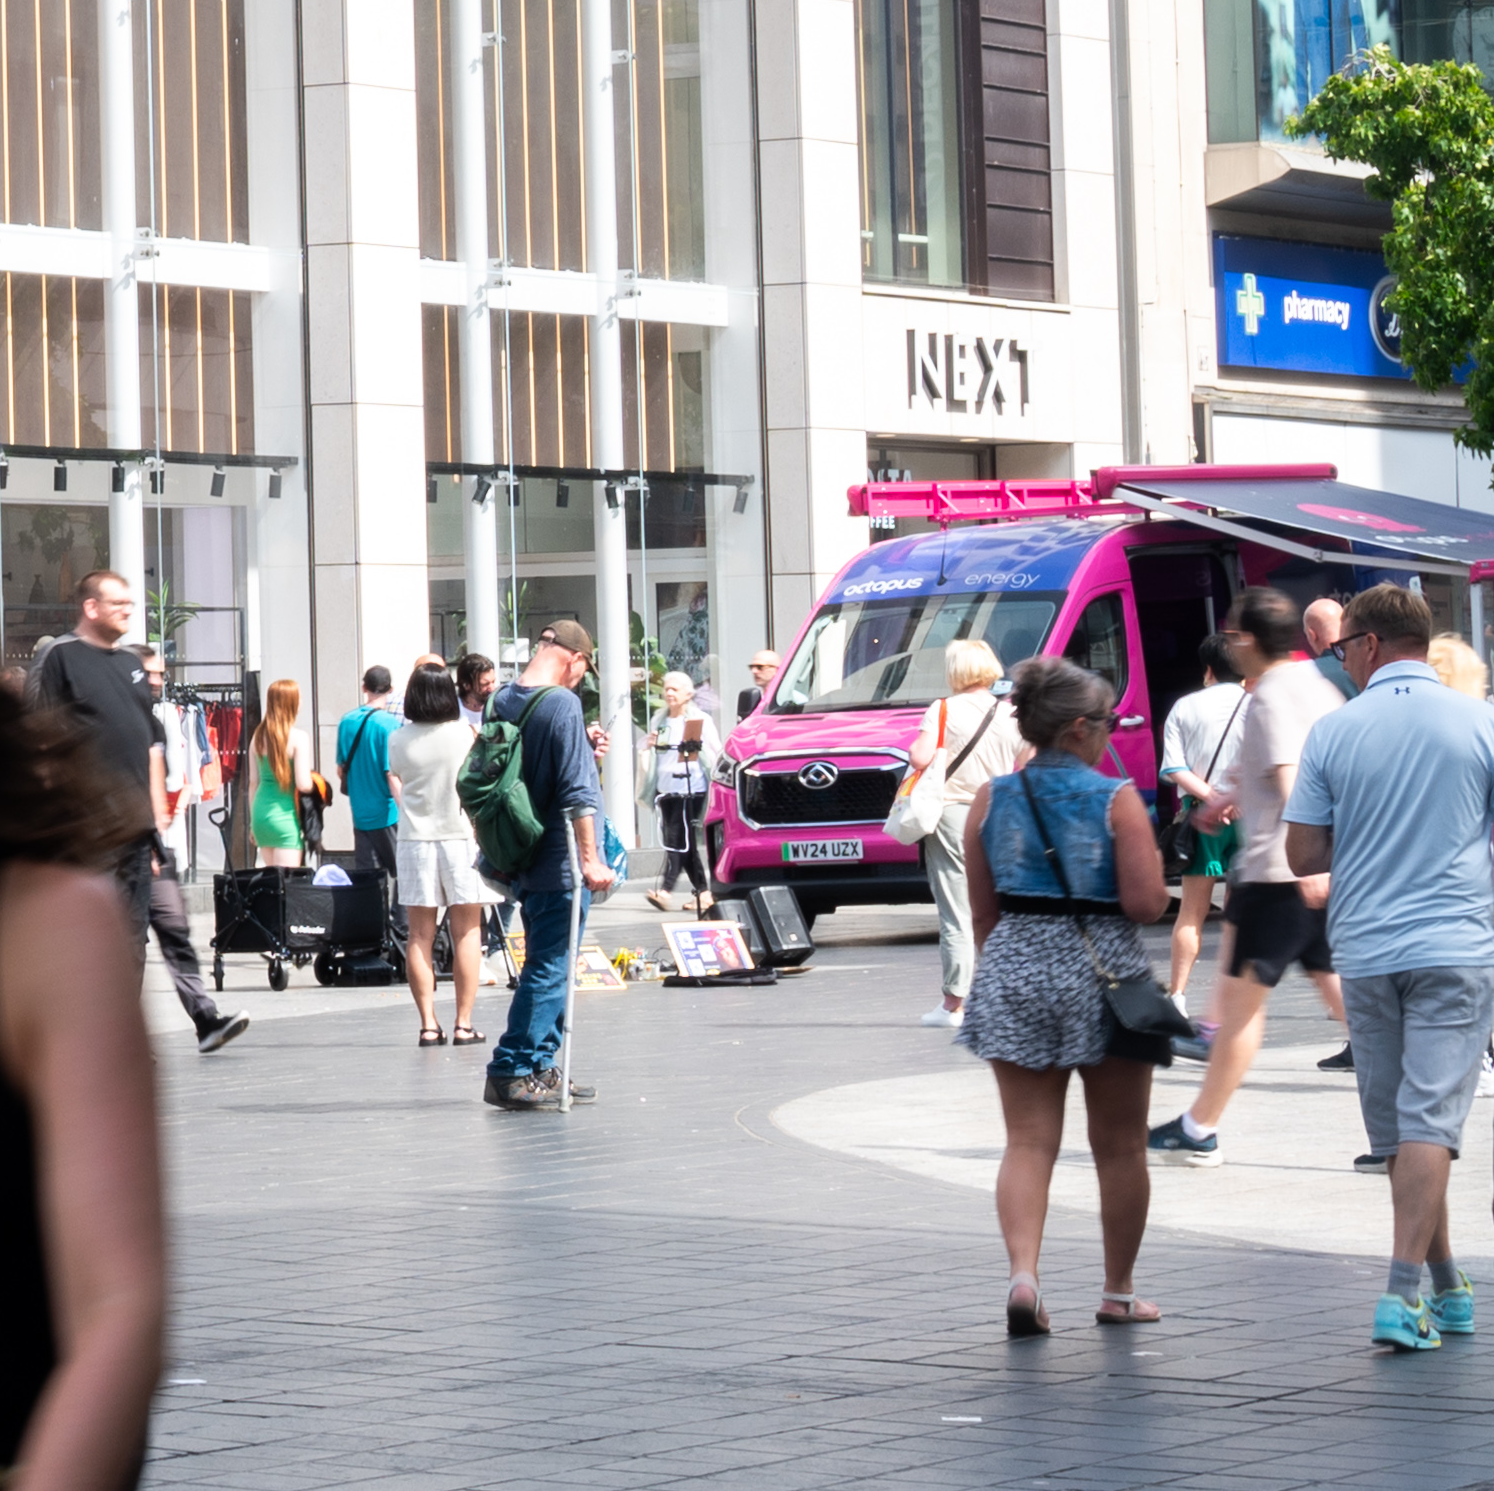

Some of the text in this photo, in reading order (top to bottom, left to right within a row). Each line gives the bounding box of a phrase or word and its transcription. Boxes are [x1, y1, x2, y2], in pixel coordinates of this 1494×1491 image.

[1283, 290, 1350, 330] pharmacy
[906, 329, 1036, 417] NEXT
[843, 572, 1041, 596] octopus energy
[791, 841, 860, 859] WV24 UZX
